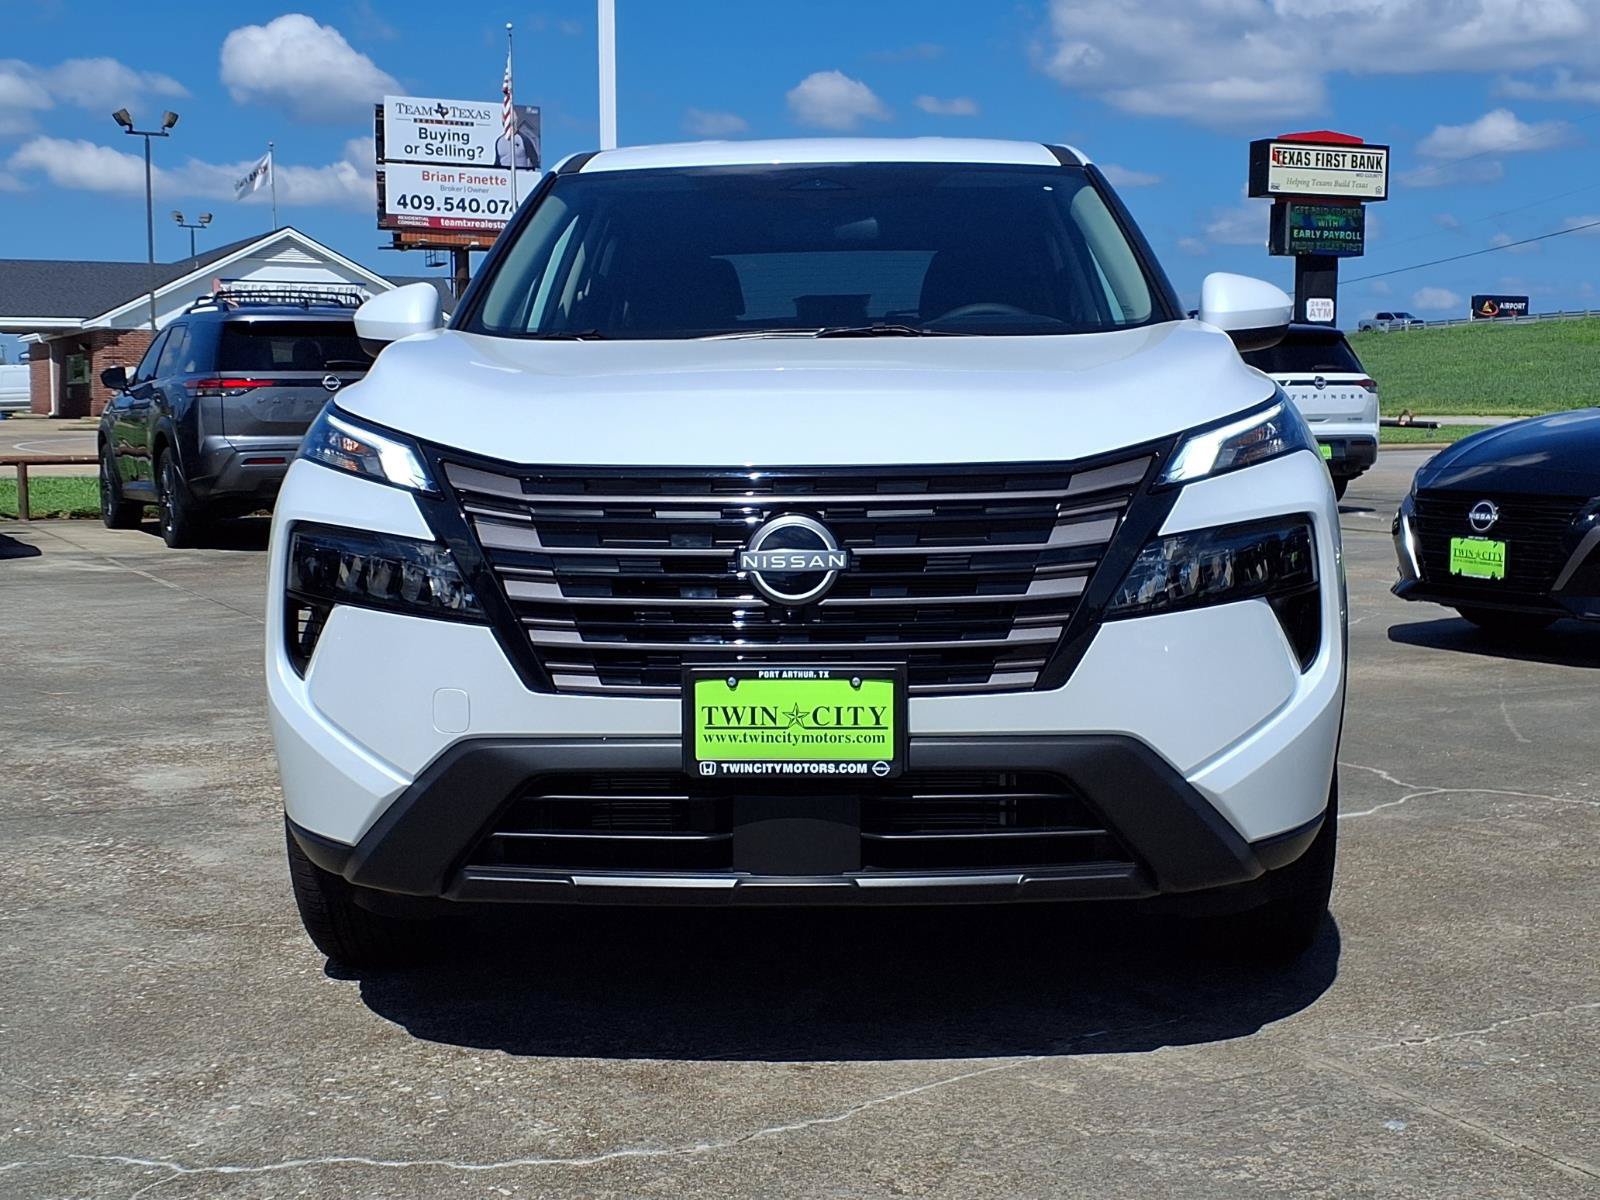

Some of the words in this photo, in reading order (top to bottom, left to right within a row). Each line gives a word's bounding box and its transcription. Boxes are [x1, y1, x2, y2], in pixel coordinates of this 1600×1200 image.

[396, 102, 432, 116] TEAM
[450, 106, 491, 120] TEXAS
[418, 127, 470, 145] Buying
[404, 144, 420, 154] or
[424, 143, 484, 160] Selling?
[1275, 150, 1311, 166] TEXAS
[1315, 152, 1347, 168] FIRST
[1351, 154, 1383, 170] BANK
[422, 170, 455, 182] Brian
[458, 172, 508, 186] Fanette
[1286, 177, 1310, 188] Helping
[1312, 178, 1332, 187] Texans
[1334, 180, 1350, 188] Build
[1352, 180, 1368, 188] Texas
[1318, 220, 1338, 228] WITH
[1293, 229, 1321, 238] EARLY
[1322, 230, 1362, 240] PAYROLL
[1309, 308, 1332, 318] ATM
[1500, 302, 1526, 310] AIRPORT
[742, 554, 844, 568] NISSAN
[701, 705, 779, 726] TWIN
[812, 705, 888, 726] CITY
[703, 730, 886, 746] www.twincitymotors.com
[720, 762, 868, 774] TWINCITYMOTORS.COM
